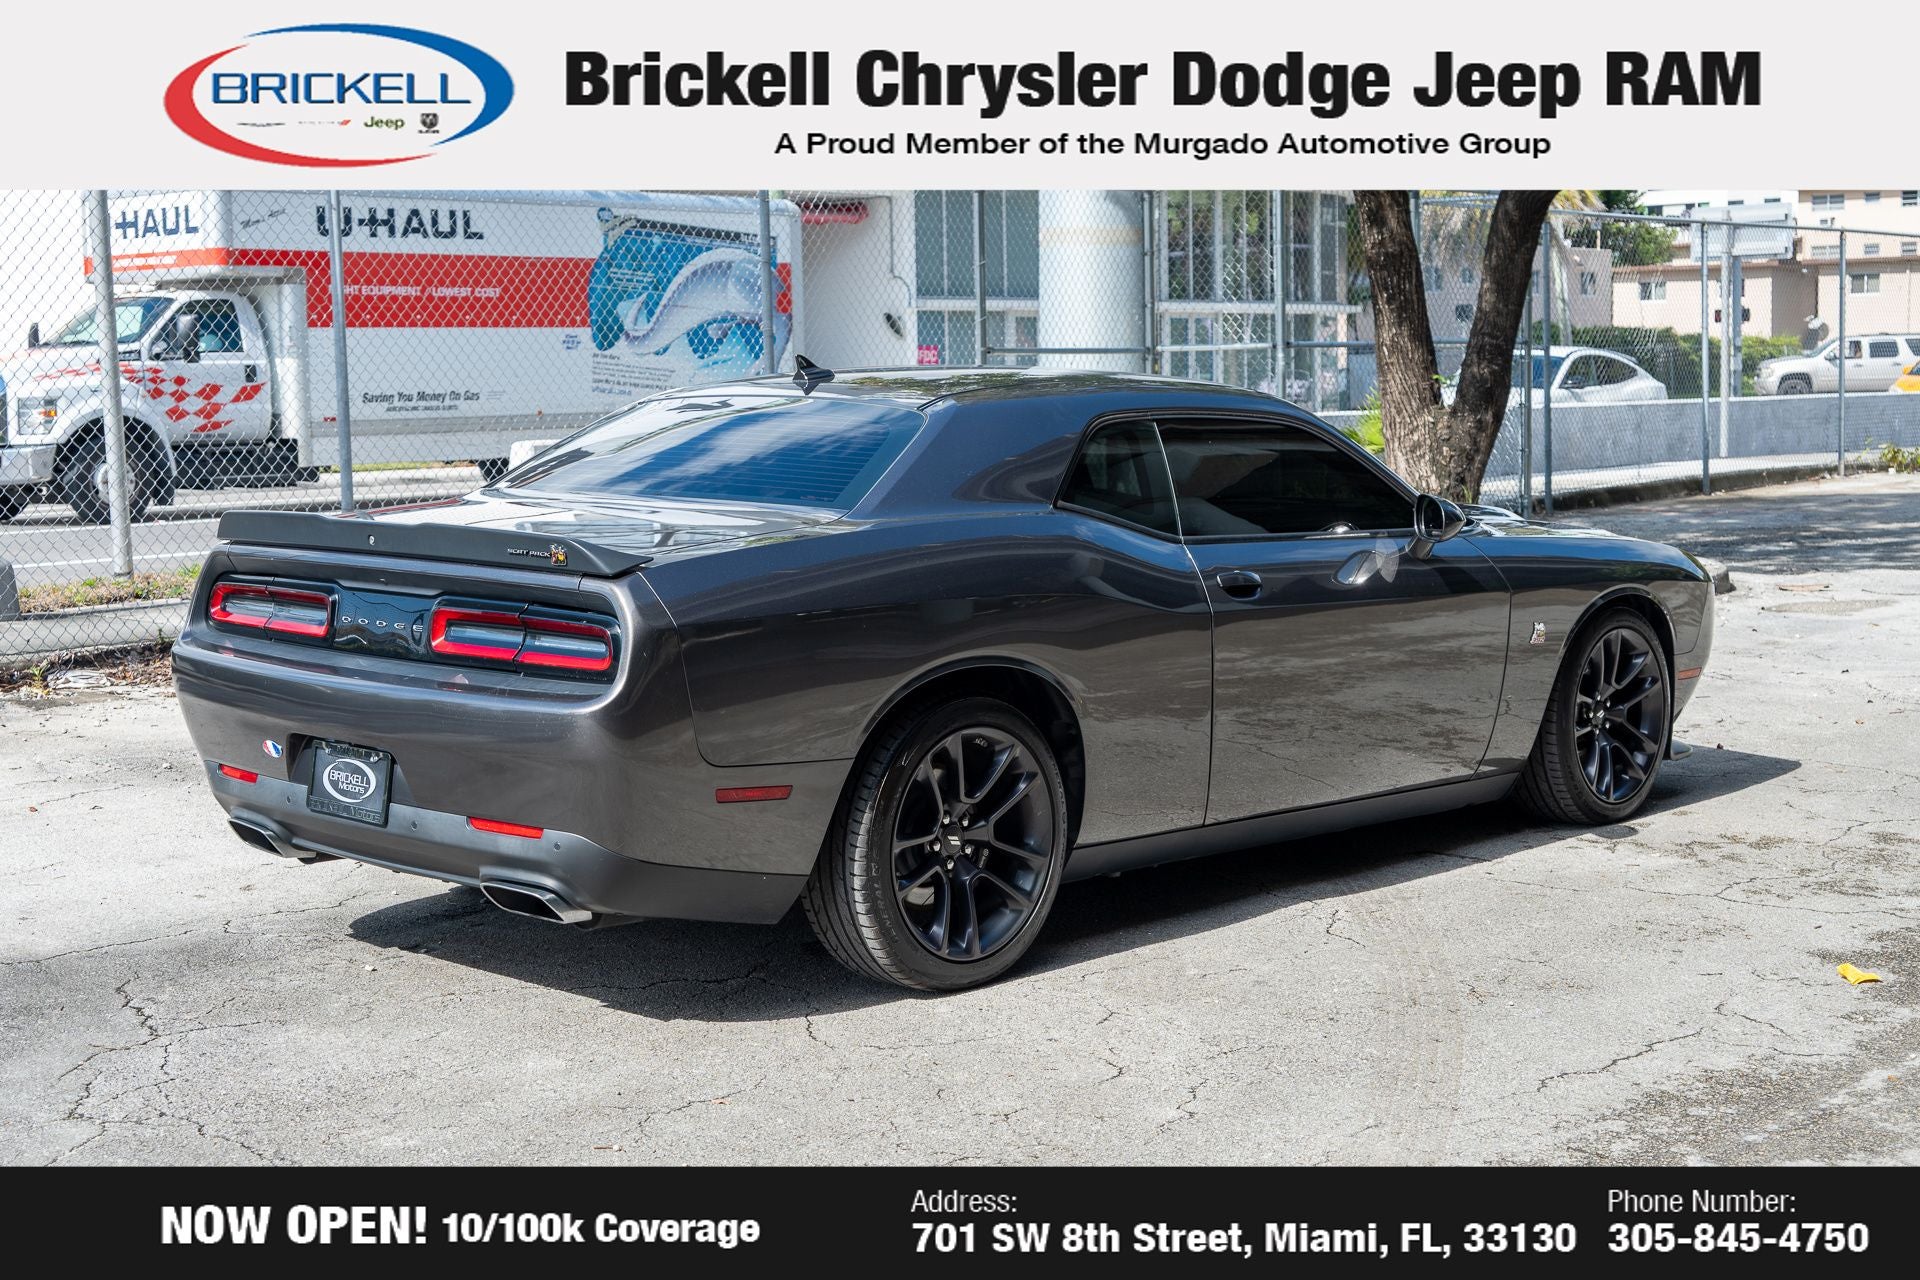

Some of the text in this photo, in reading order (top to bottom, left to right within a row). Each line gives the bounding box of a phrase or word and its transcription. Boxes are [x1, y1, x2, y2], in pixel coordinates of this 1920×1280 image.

[109, 205, 199, 239] -HAUL
[361, 285, 421, 296] EQUIPMENT
[432, 286, 472, 297] LOWEST
[475, 288, 501, 298] COST
[362, 390, 480, 404] Saving You Money On Gas
[341, 615, 424, 632] DODGE
[329, 769, 370, 788] BRICKELL
[338, 781, 365, 794] Motors
